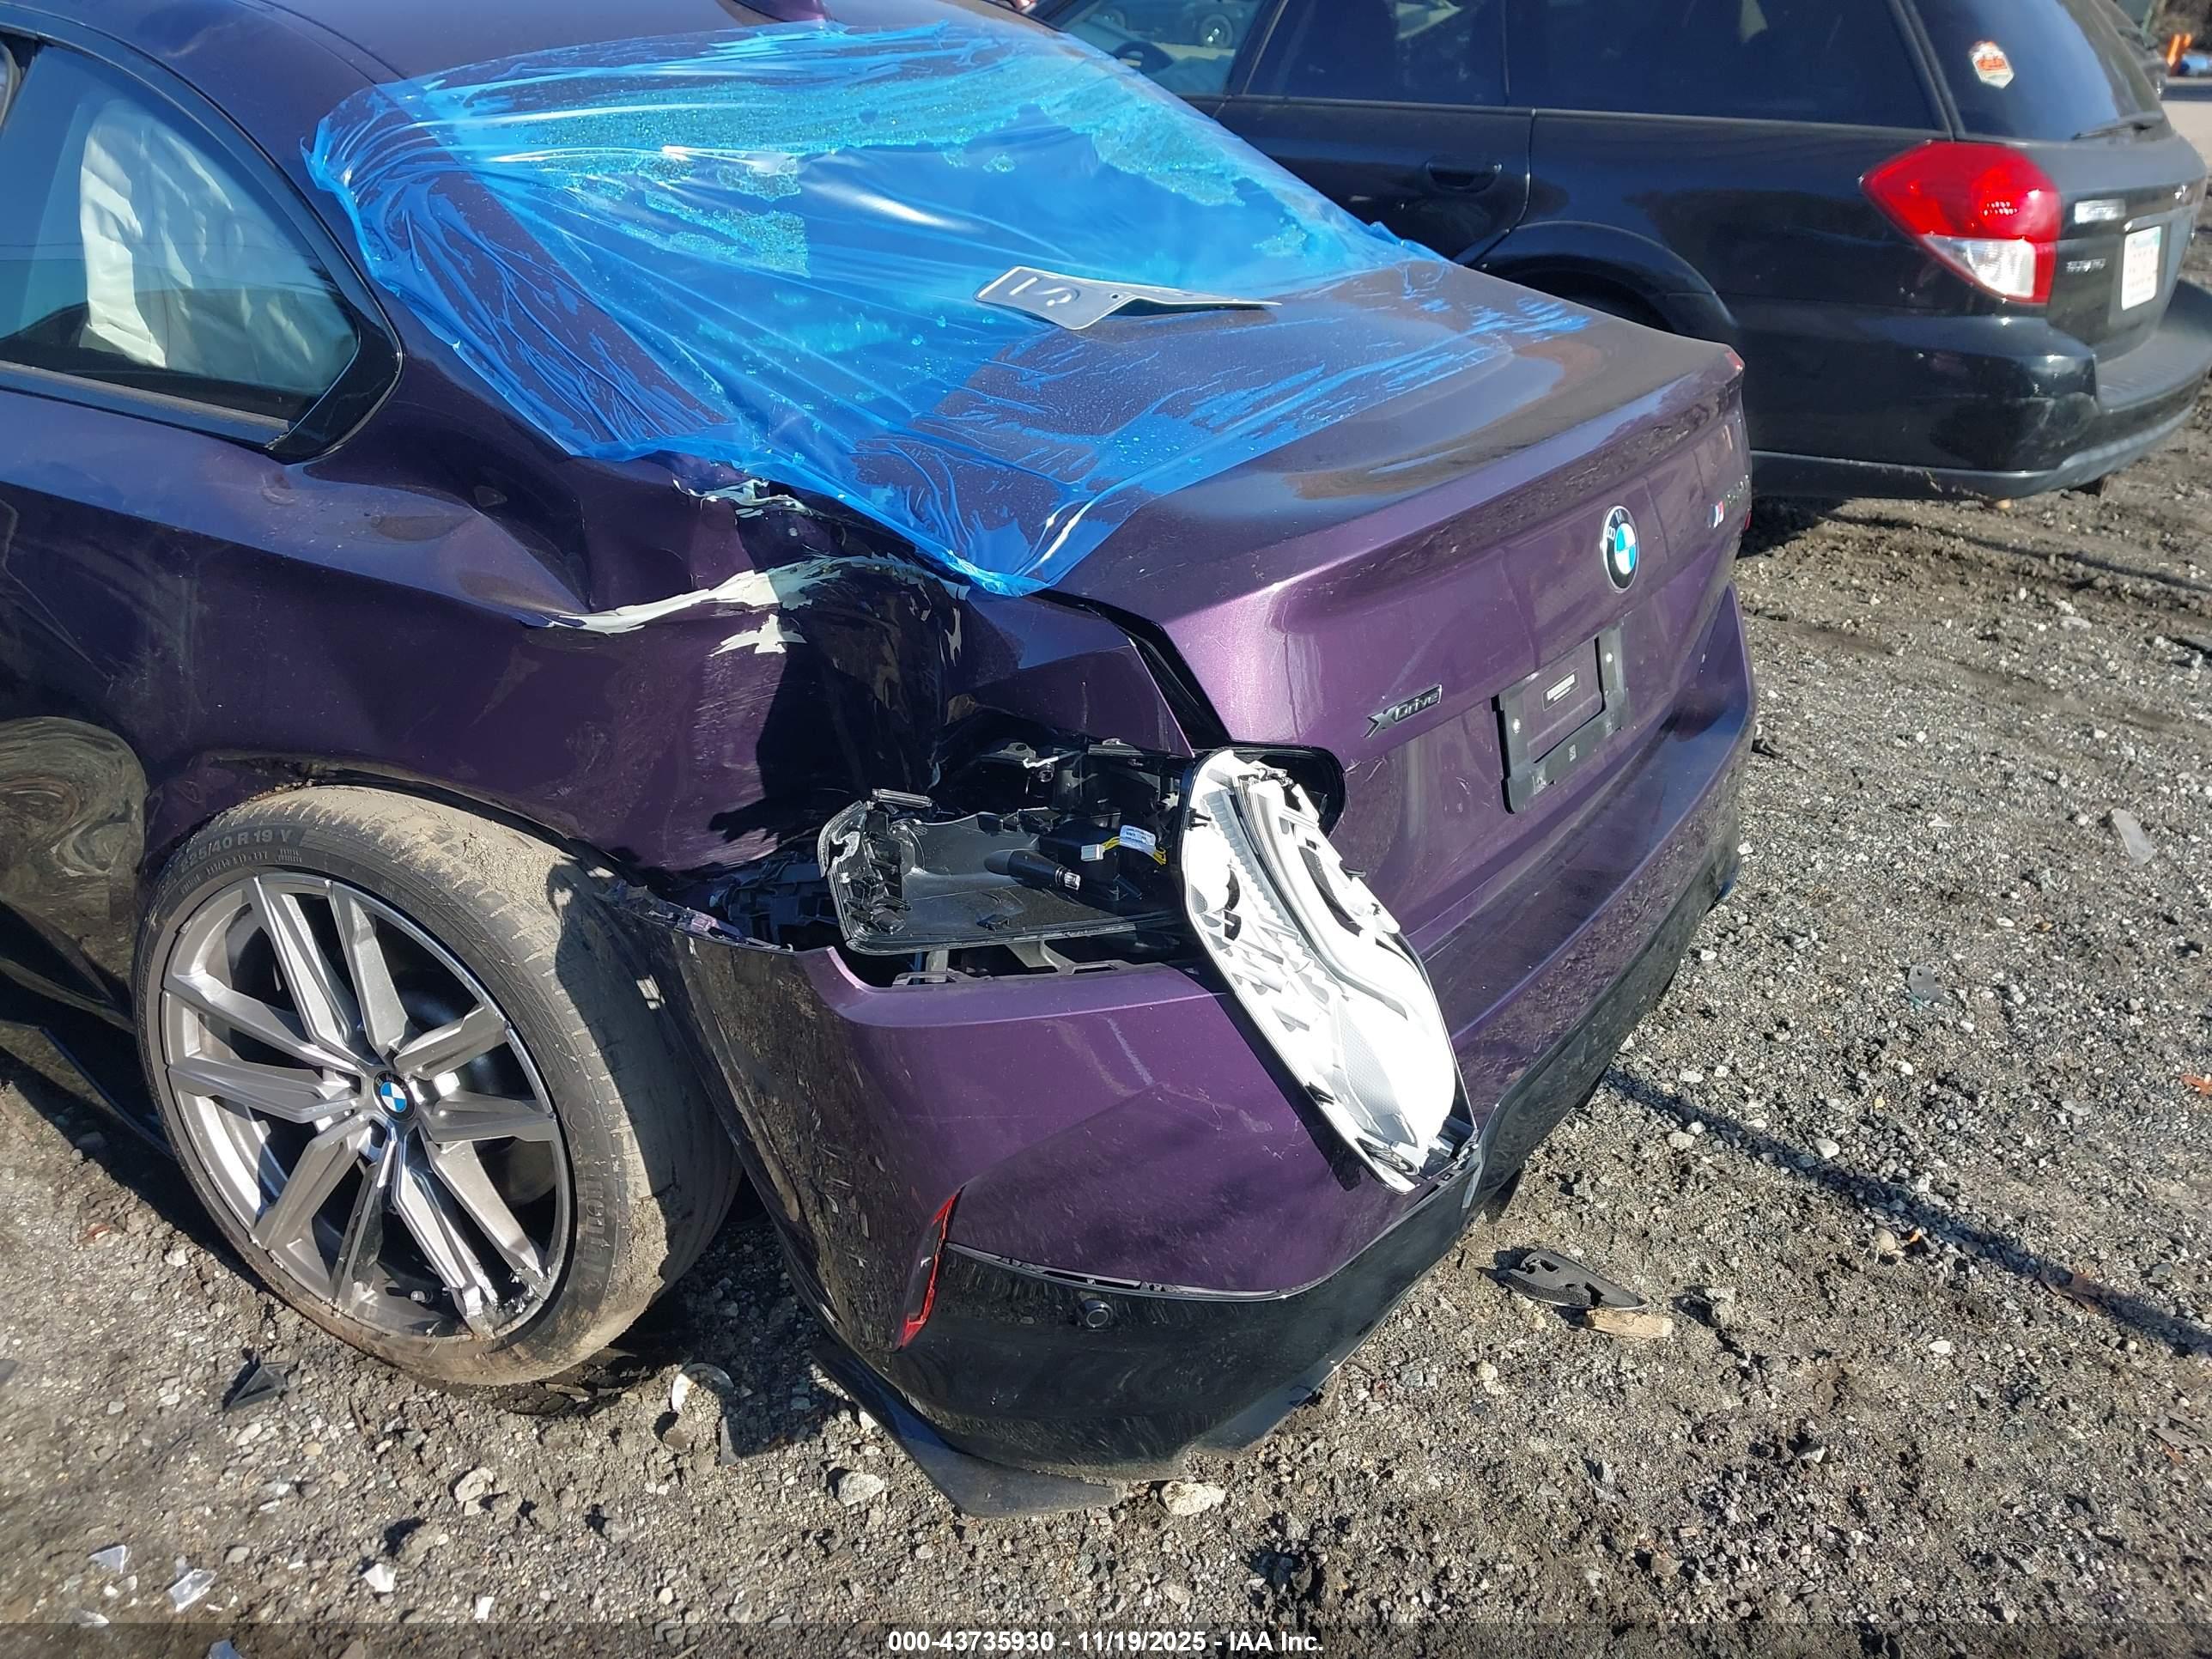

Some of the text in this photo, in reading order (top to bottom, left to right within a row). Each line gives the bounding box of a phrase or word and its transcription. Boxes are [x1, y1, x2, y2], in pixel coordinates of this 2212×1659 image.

[237, 831, 249, 845] R
[253, 829, 273, 843] 19
[280, 829, 294, 842] V
